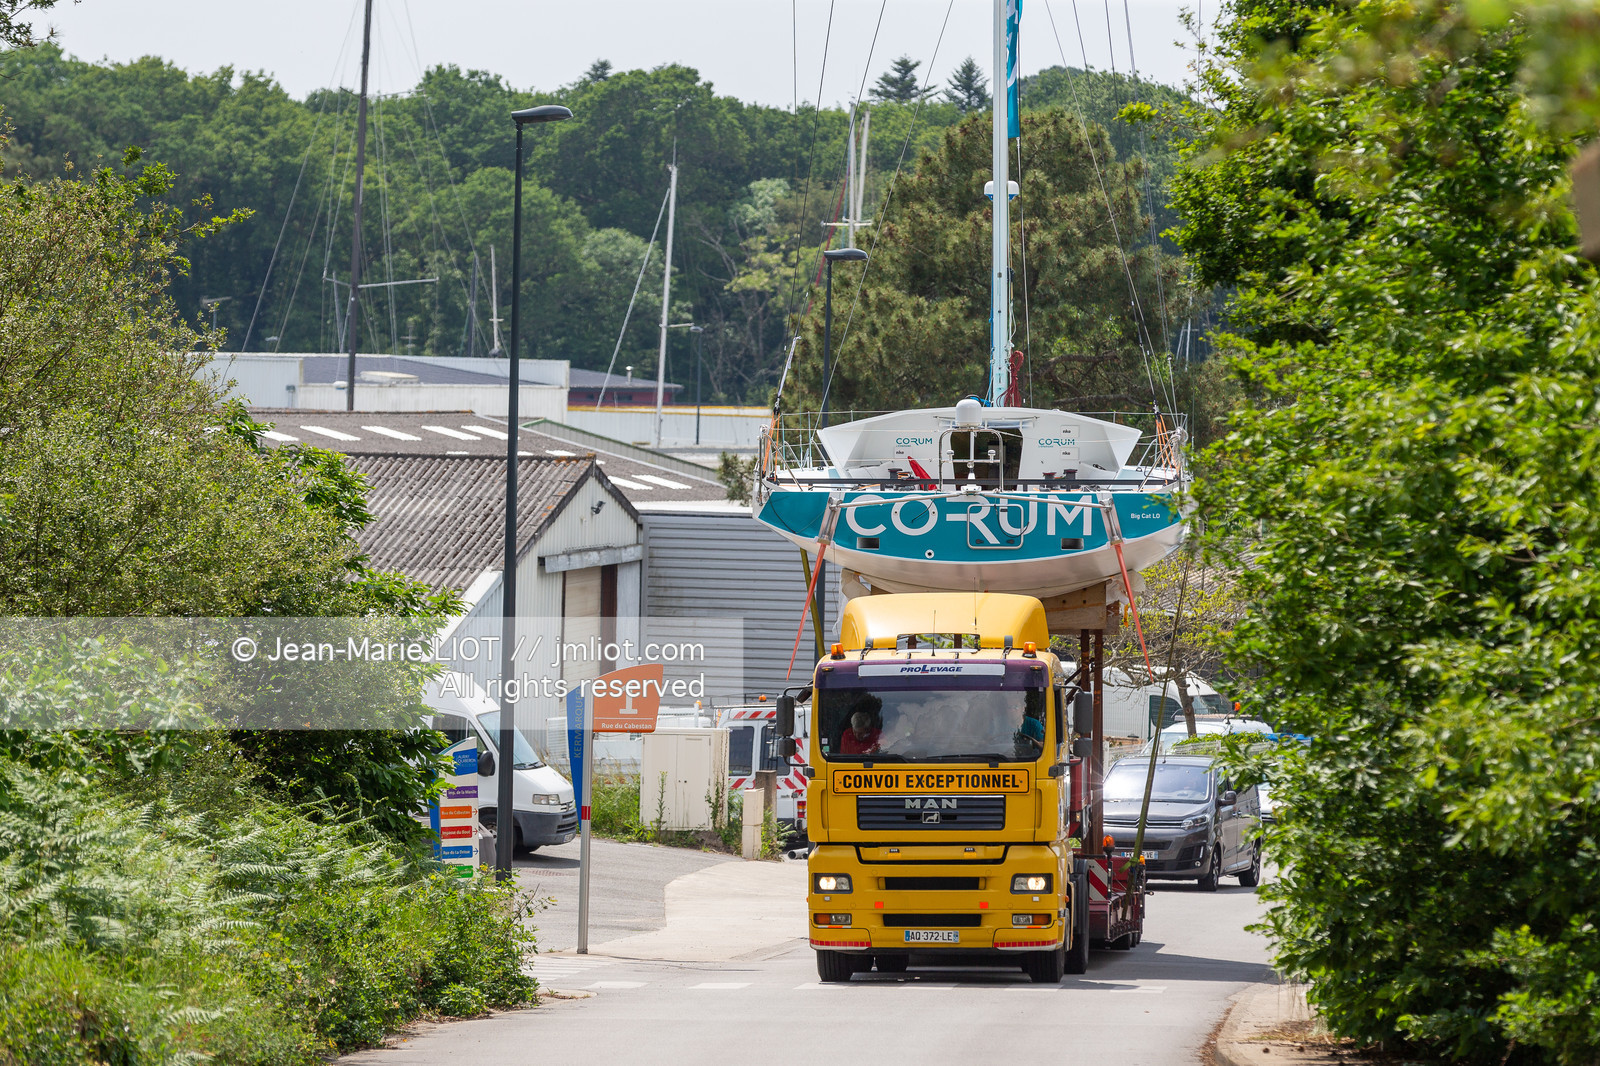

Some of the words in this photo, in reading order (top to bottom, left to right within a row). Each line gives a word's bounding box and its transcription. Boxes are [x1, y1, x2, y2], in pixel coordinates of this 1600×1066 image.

[896, 437, 933, 446] CORUM
[1038, 438, 1075, 447] CORUM
[846, 494, 1092, 544] CORUM
[623, 722, 653, 730] Cabestan
[842, 774, 899, 789] CONVOI
[905, 773, 1020, 789] EXCEPTIONNEL
[904, 798, 958, 809] MAN
